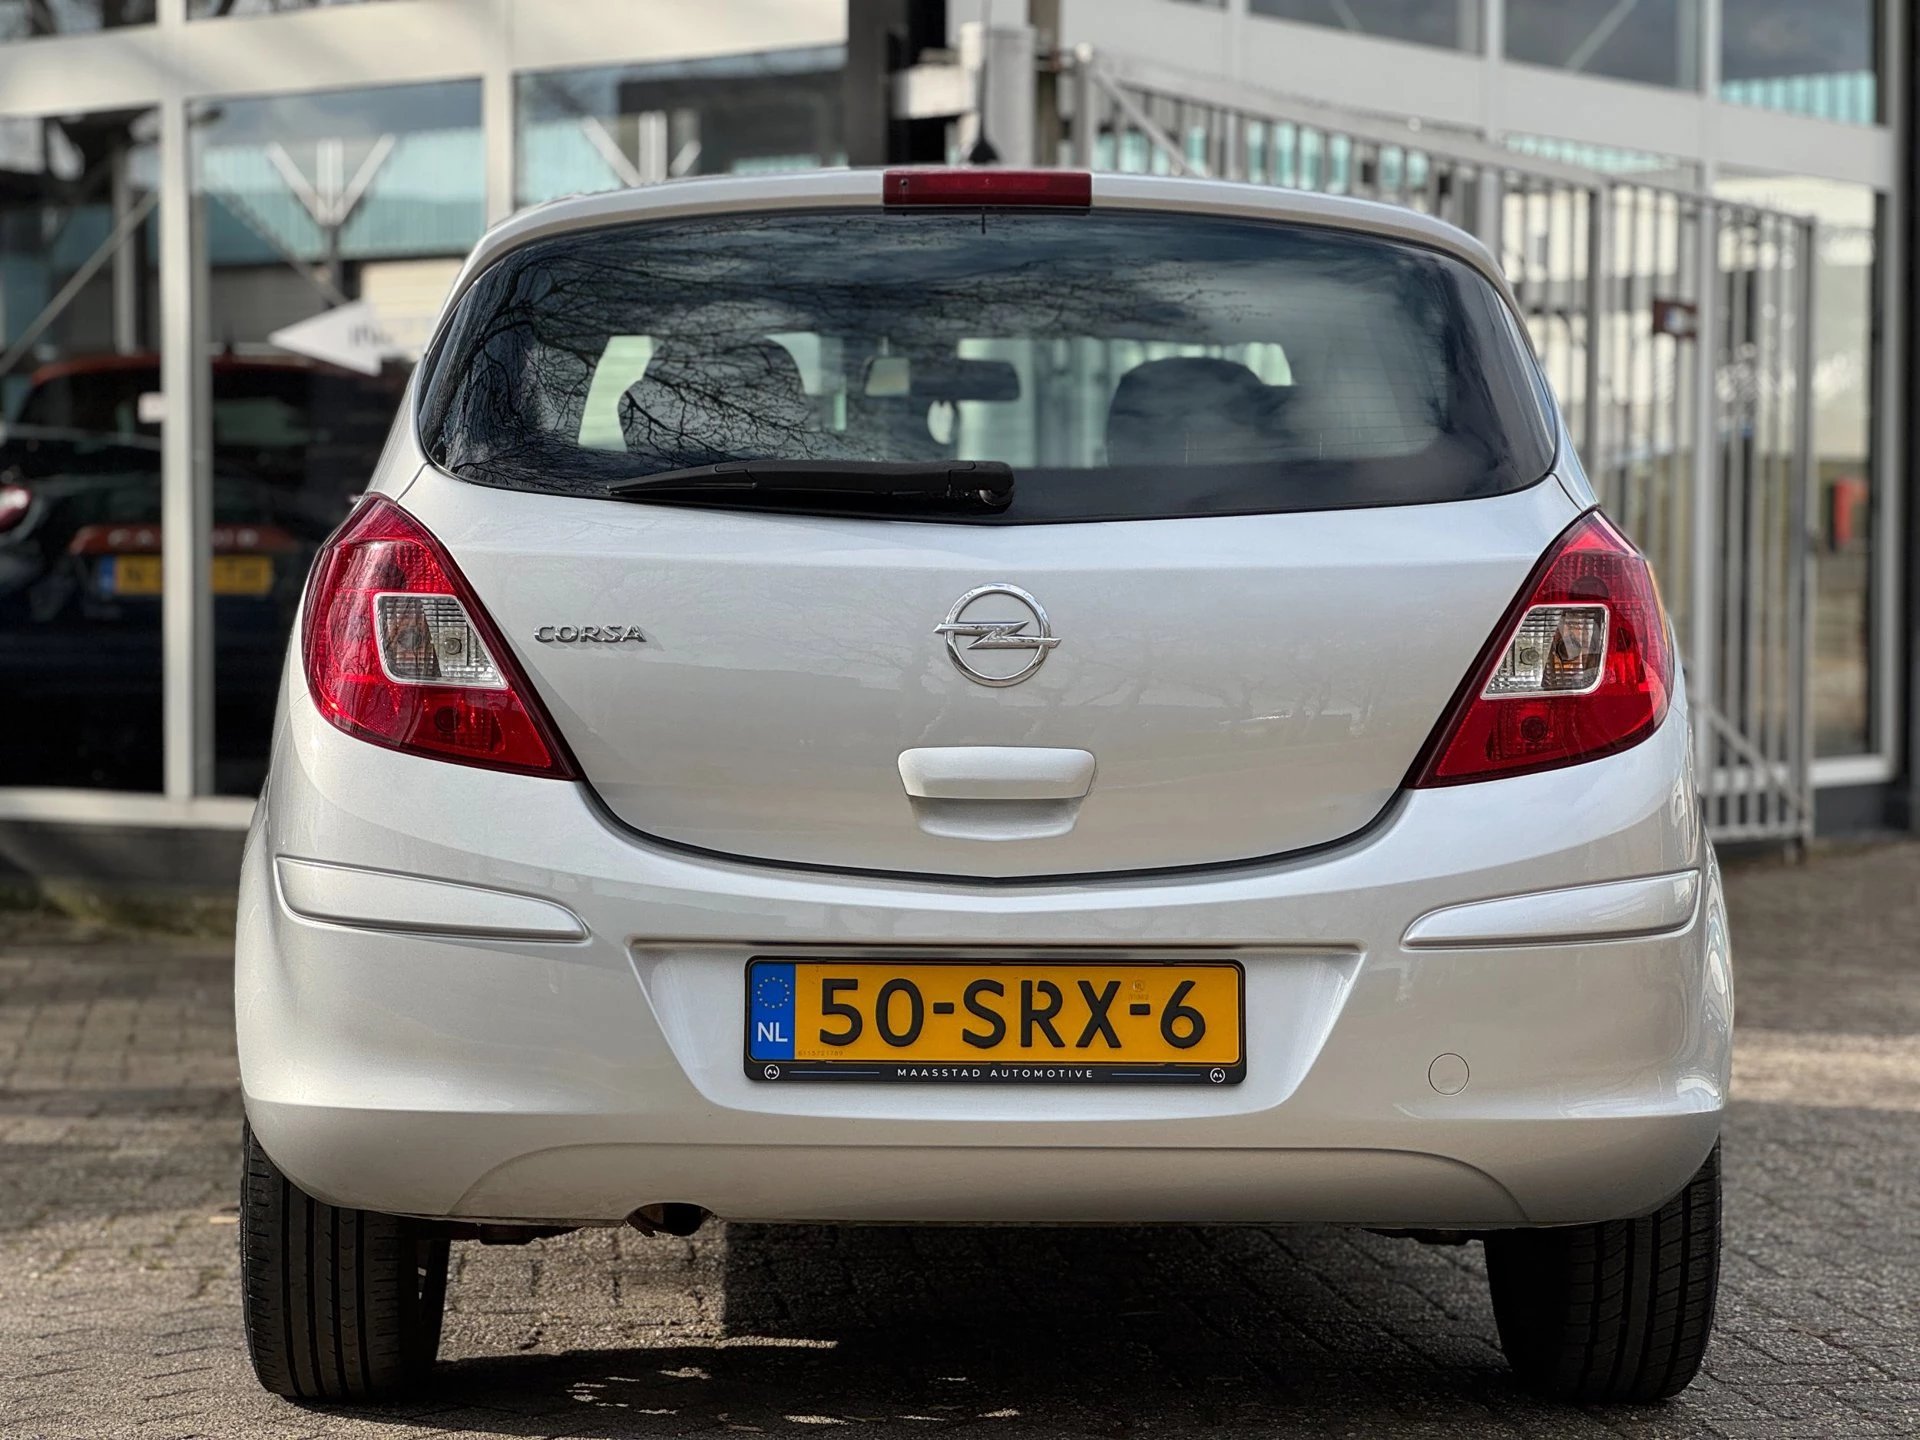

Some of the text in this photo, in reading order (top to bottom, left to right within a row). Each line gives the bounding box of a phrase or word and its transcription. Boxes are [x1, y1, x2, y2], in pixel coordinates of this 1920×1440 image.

[534, 624, 647, 643] CORSA
[819, 978, 1207, 1050] 50-SRX-6
[757, 1021, 789, 1043] NL
[897, 1068, 1094, 1079] MAASSTAD AUTOMOTIVE
